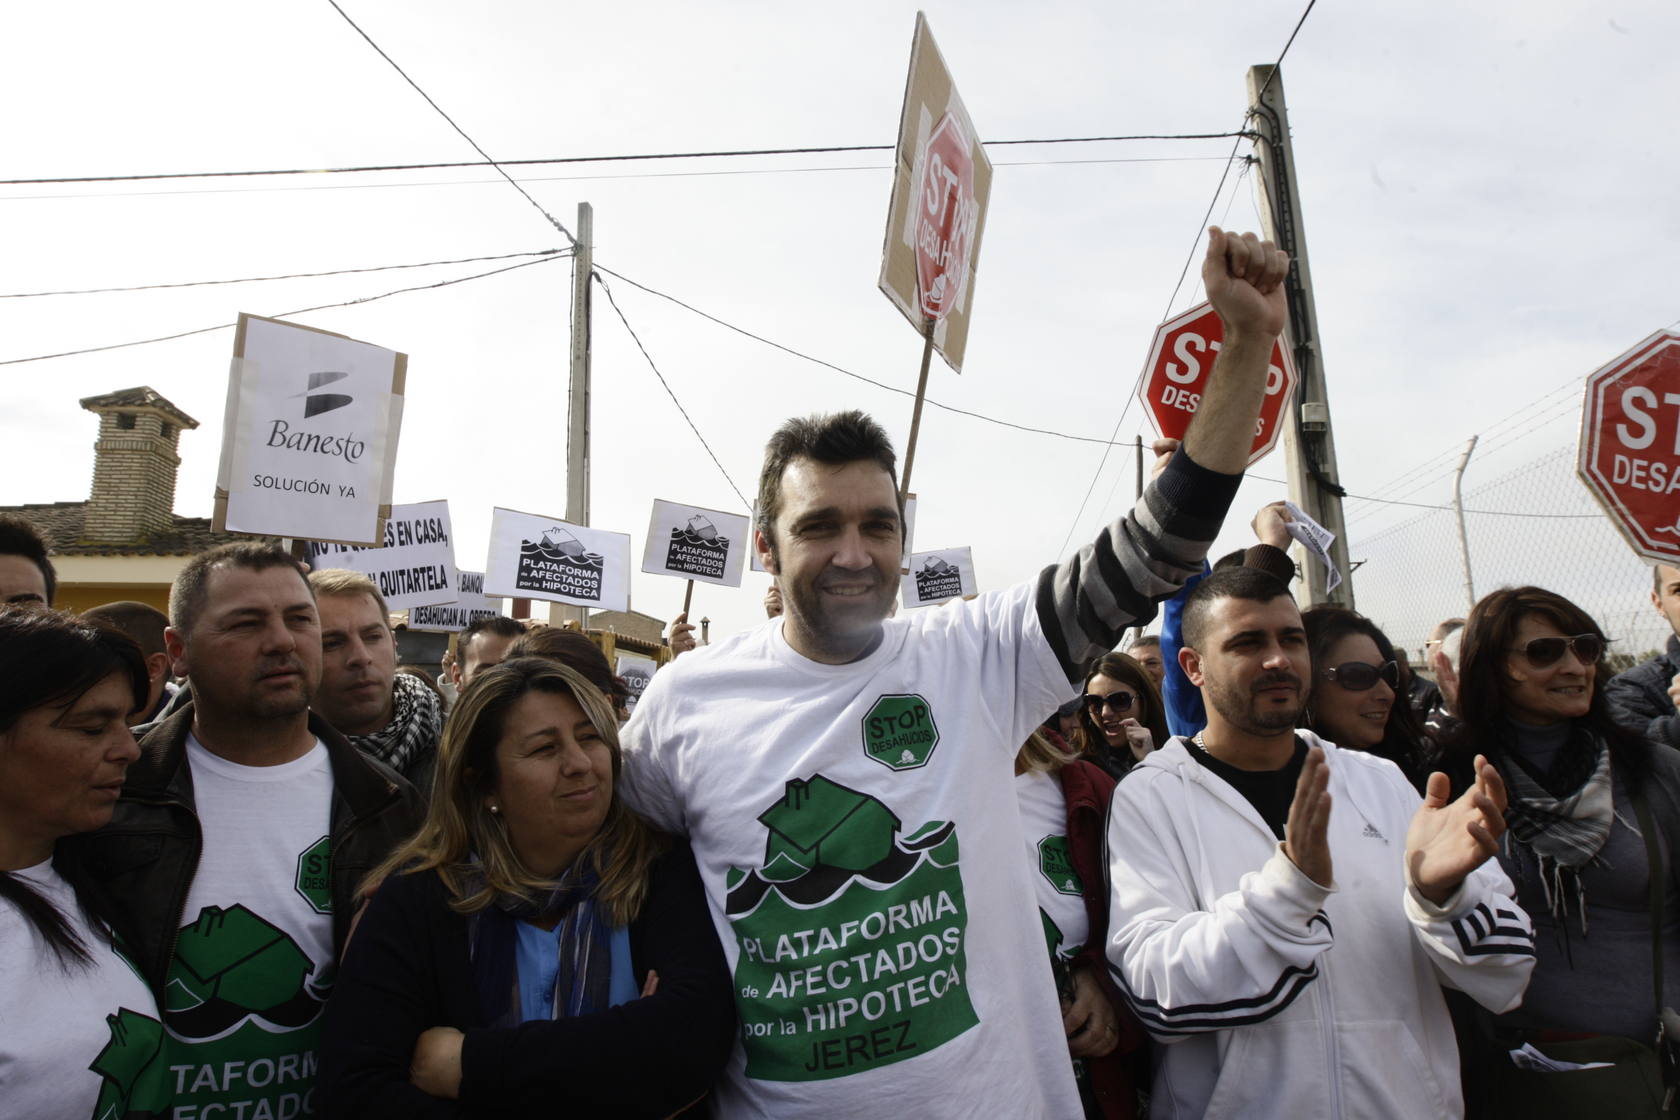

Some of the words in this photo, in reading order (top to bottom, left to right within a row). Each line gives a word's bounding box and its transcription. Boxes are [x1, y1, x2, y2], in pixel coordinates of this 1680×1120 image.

[266, 419, 365, 465] Banesto
[253, 474, 331, 496] SOLUCIÓN
[338, 484, 356, 499] YA
[396, 520, 413, 547] EN
[415, 517, 448, 547] CASA,
[671, 543, 725, 561] PLATAFORMA
[675, 553, 724, 569] AFECTADOS
[522, 558, 600, 580] PLATAFORMA
[530, 569, 599, 589] AFECTADOS
[683, 562, 722, 576] HIPOTECA
[380, 564, 448, 598] QUITARTELA
[542, 580, 599, 598] HIPOTECA
[917, 577, 960, 588] PLATAFORMA
[924, 583, 960, 593] AFECTADOS
[931, 589, 961, 598] HIPOTECA
[414, 606, 459, 627] DESAHUCIAN
[459, 607, 468, 628] AL
[870, 704, 926, 740] STOP
[871, 729, 932, 754] DESAHUCIOS
[743, 889, 959, 964] PLATAFORMA
[741, 984, 759, 999] de
[765, 926, 961, 999] AFECTADOS
[744, 1020, 774, 1041] por
[780, 1018, 797, 1035] la
[802, 963, 961, 1033] HIPOTECA
[804, 1019, 917, 1073] JEREZ
